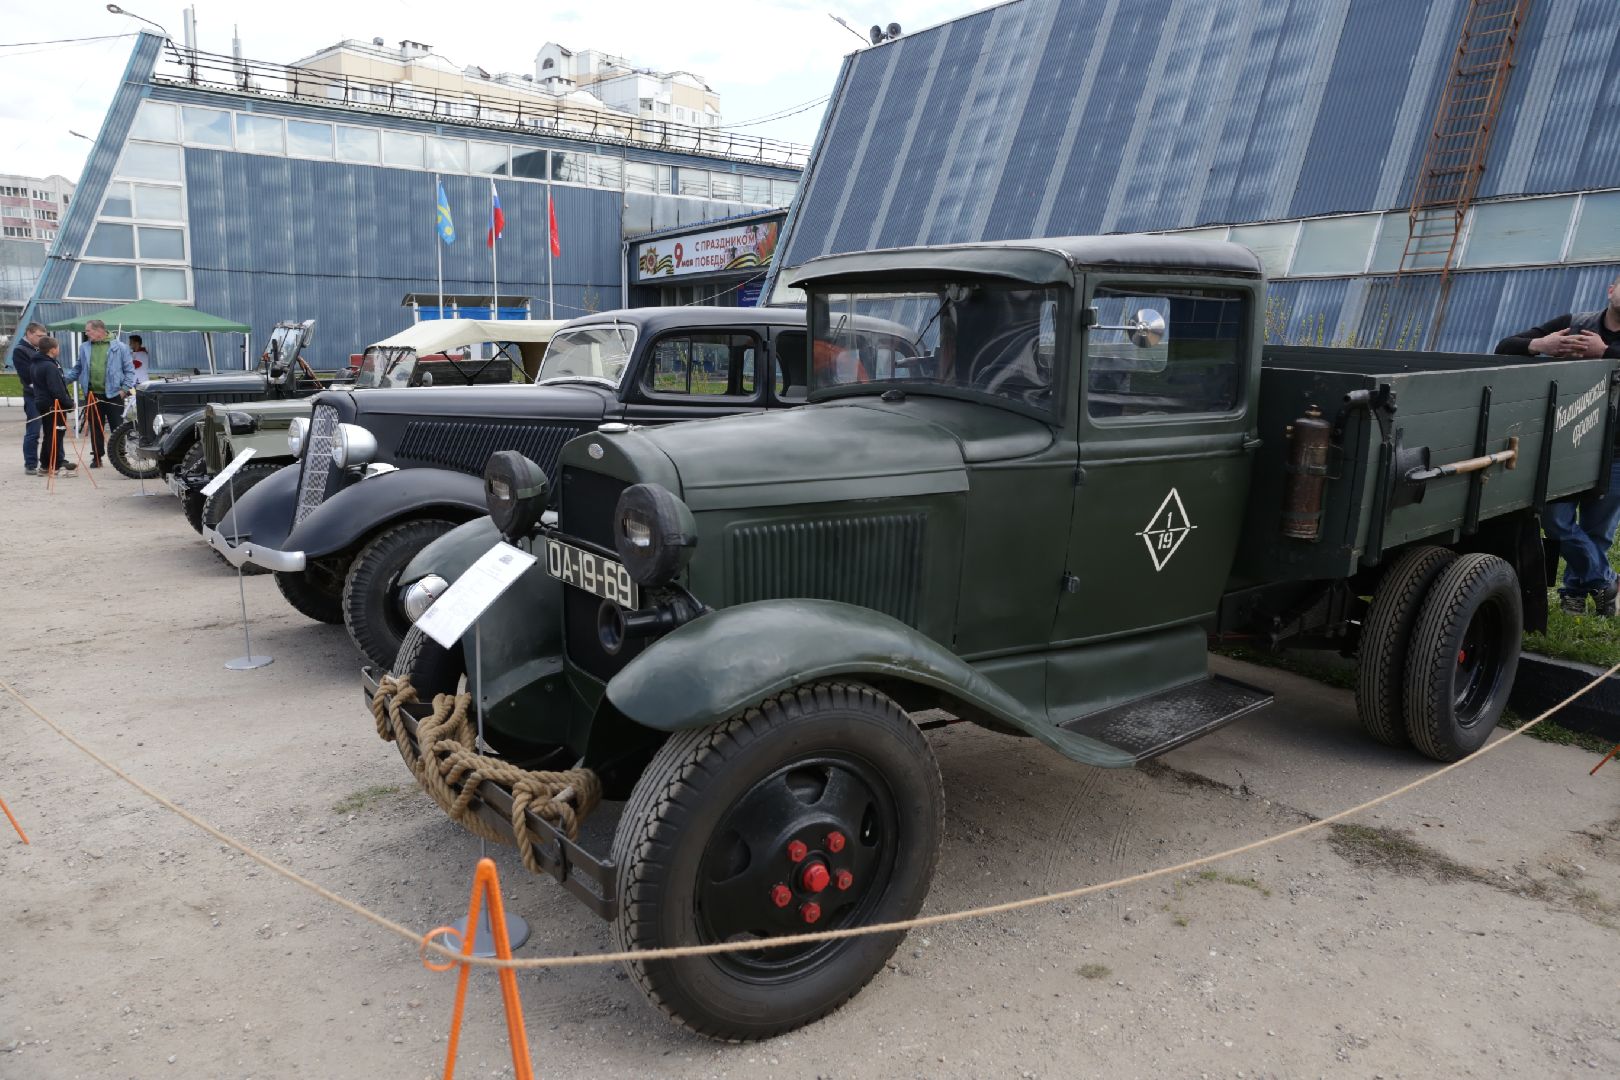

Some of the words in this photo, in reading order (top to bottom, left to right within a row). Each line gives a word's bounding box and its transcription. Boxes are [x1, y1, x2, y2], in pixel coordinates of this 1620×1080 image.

[694, 241, 700, 252] С
[700, 234, 755, 251] ПРАЗДНИКОМ
[674, 242, 684, 268] 9
[681, 258, 694, 268] мая
[1167, 511, 1173, 529] 1
[1157, 531, 1173, 550] 19
